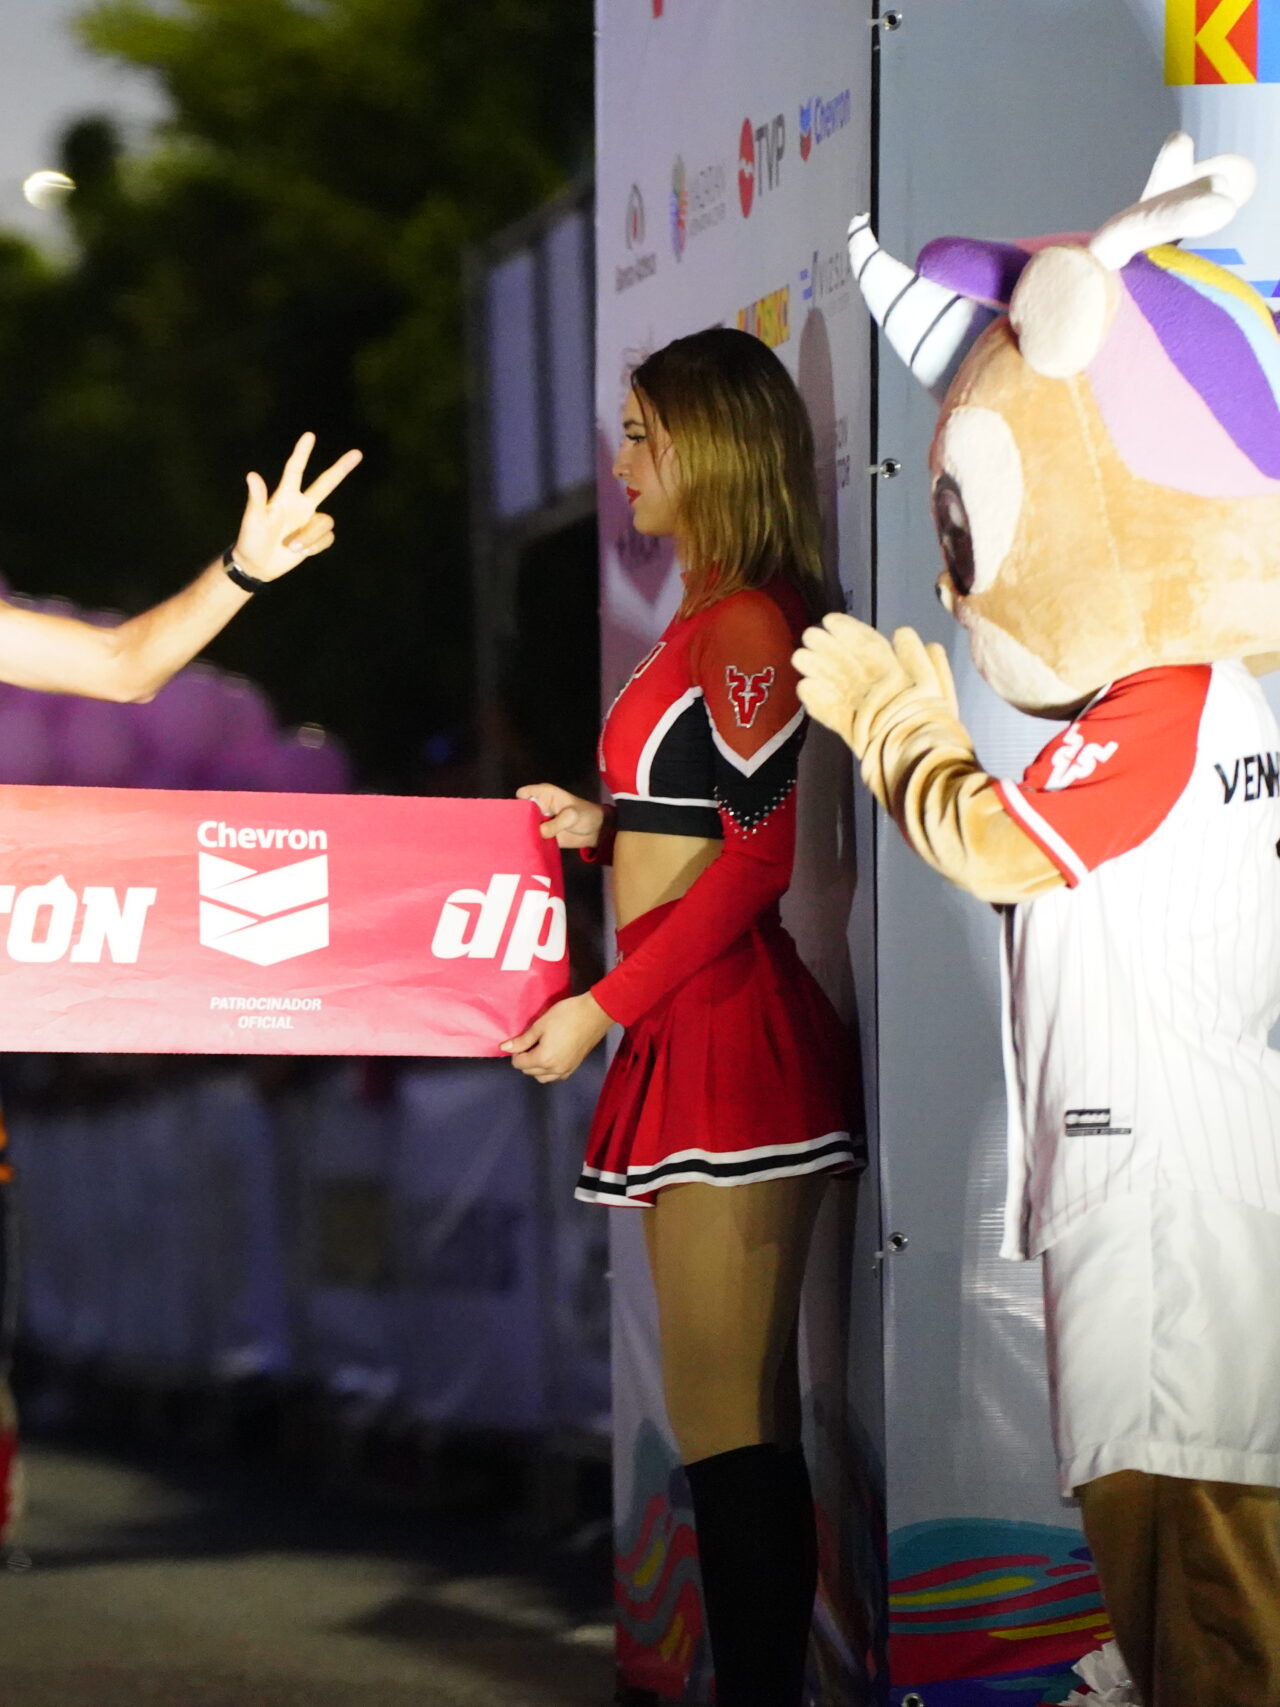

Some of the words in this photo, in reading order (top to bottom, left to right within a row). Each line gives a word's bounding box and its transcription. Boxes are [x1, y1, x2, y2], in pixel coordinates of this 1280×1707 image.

[755, 114, 785, 196] TVP
[197, 820, 328, 850] Chevron
[210, 996, 322, 1011] PATROCINADOR
[238, 1015, 294, 1030] OFICIAL
